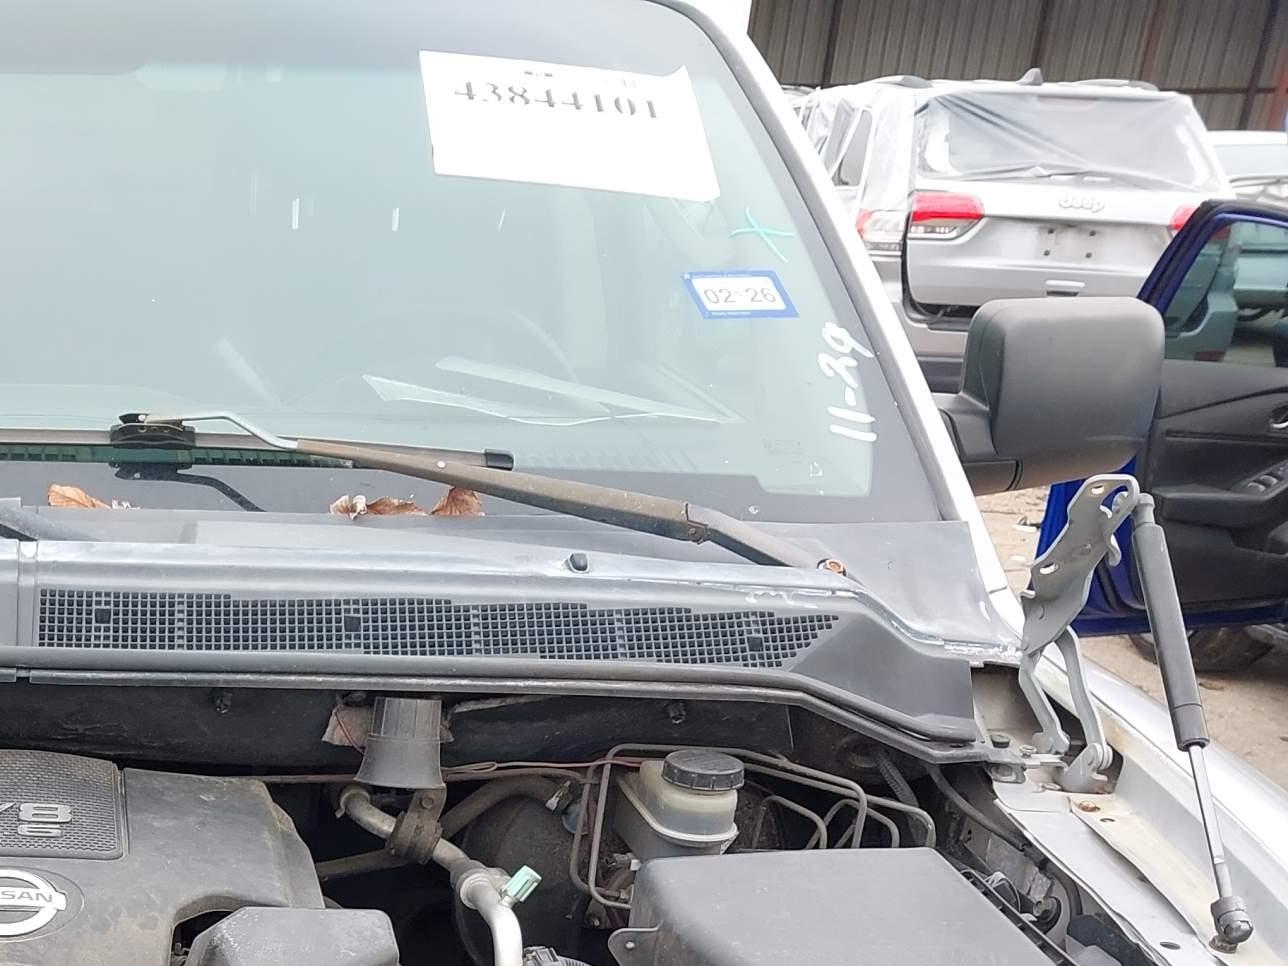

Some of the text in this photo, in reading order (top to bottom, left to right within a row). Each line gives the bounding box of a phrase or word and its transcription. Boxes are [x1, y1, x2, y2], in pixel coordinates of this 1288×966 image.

[454, 81, 657, 119] 43844101
[1058, 192, 1105, 214] Jeep
[703, 287, 776, 304] 02 26
